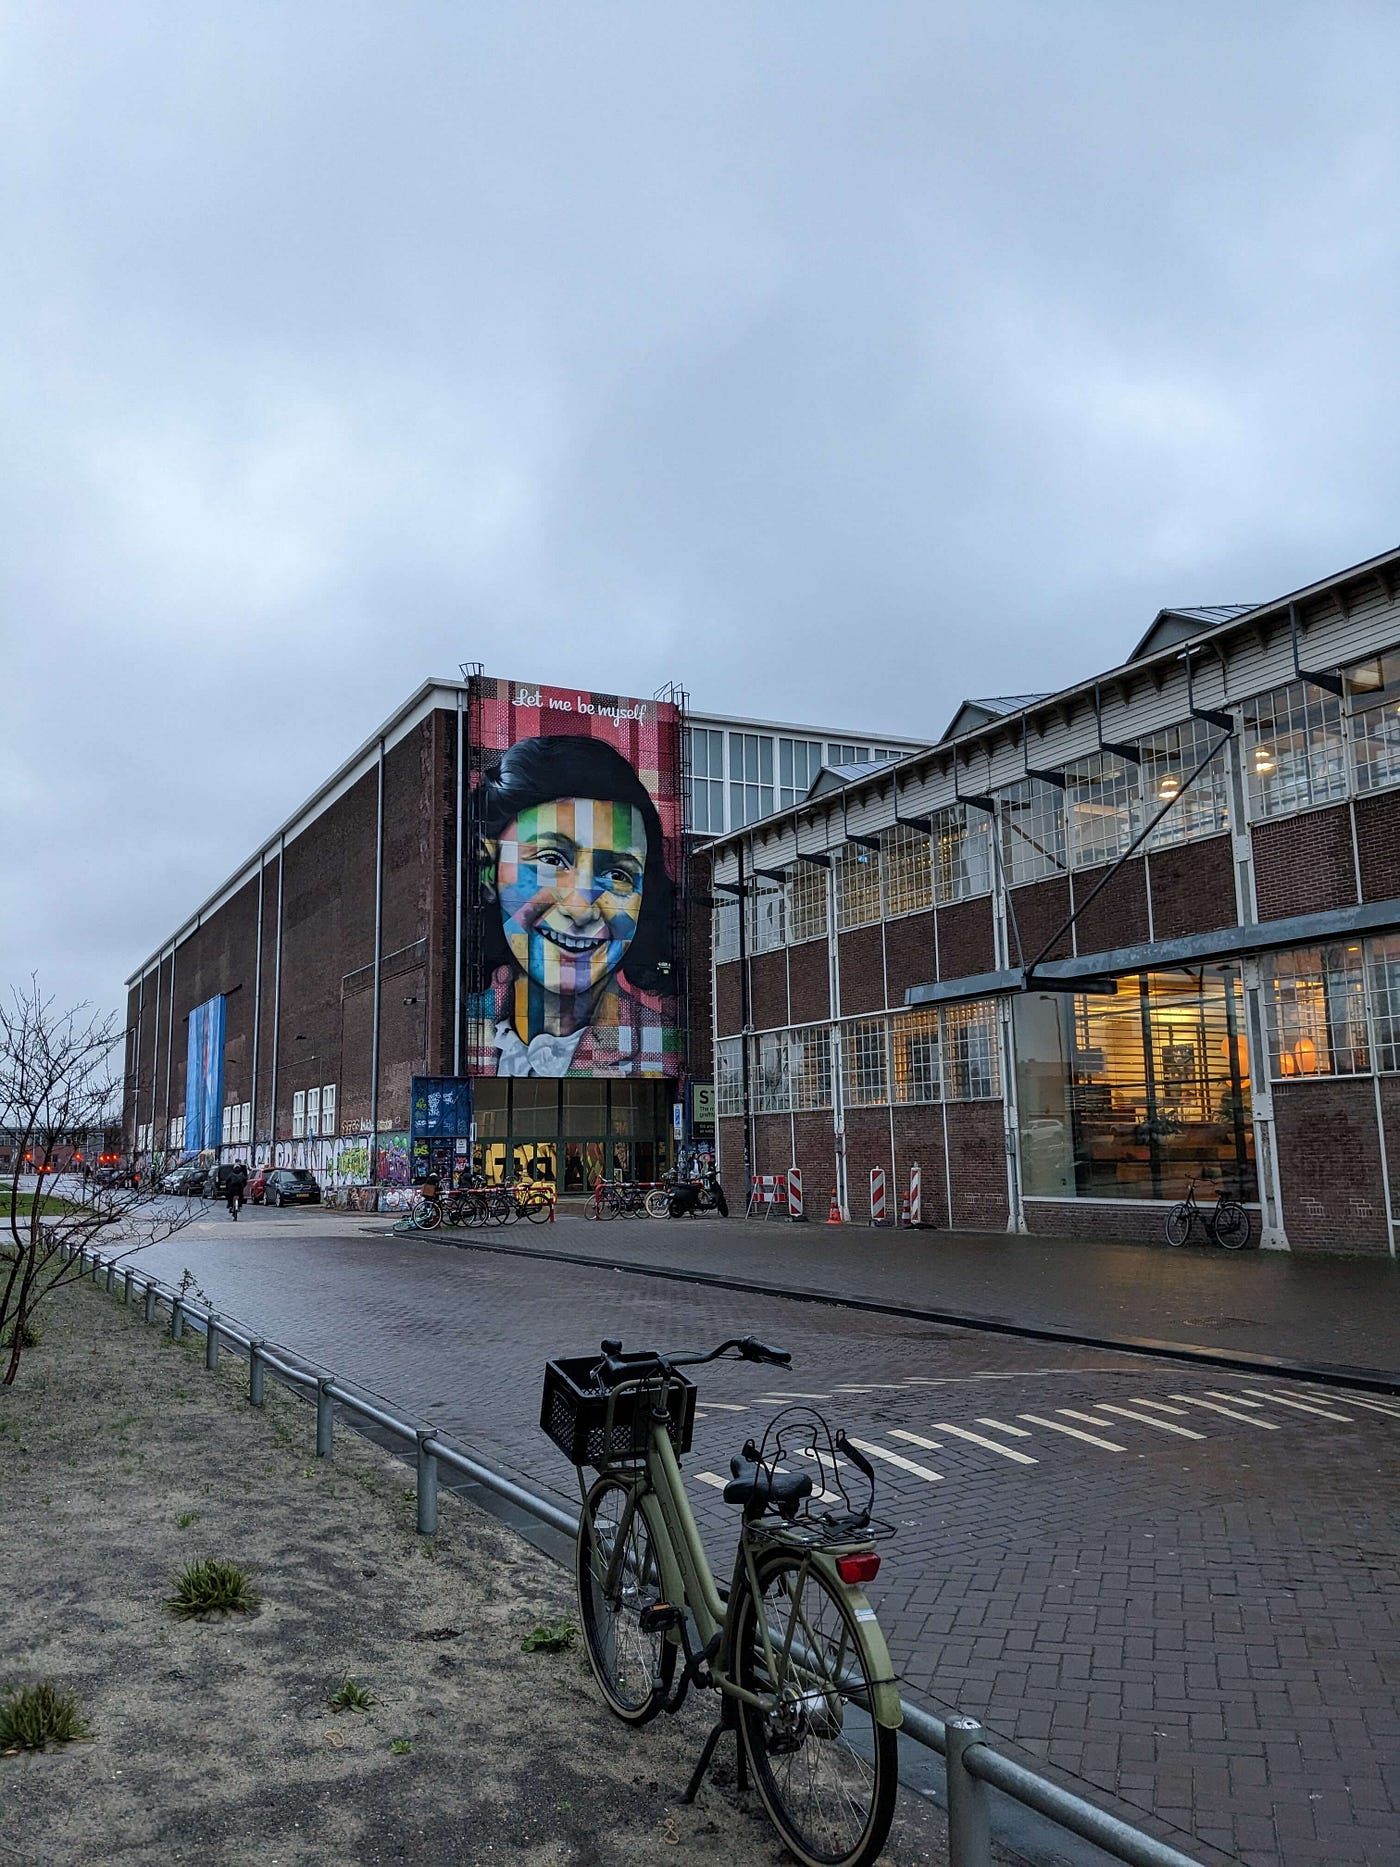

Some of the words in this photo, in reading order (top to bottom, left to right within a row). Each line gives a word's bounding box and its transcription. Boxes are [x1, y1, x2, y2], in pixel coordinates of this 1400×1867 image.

[512, 689, 543, 708] Let
[549, 698, 572, 712] me
[578, 697, 595, 714] be
[598, 704, 647, 727] myself
